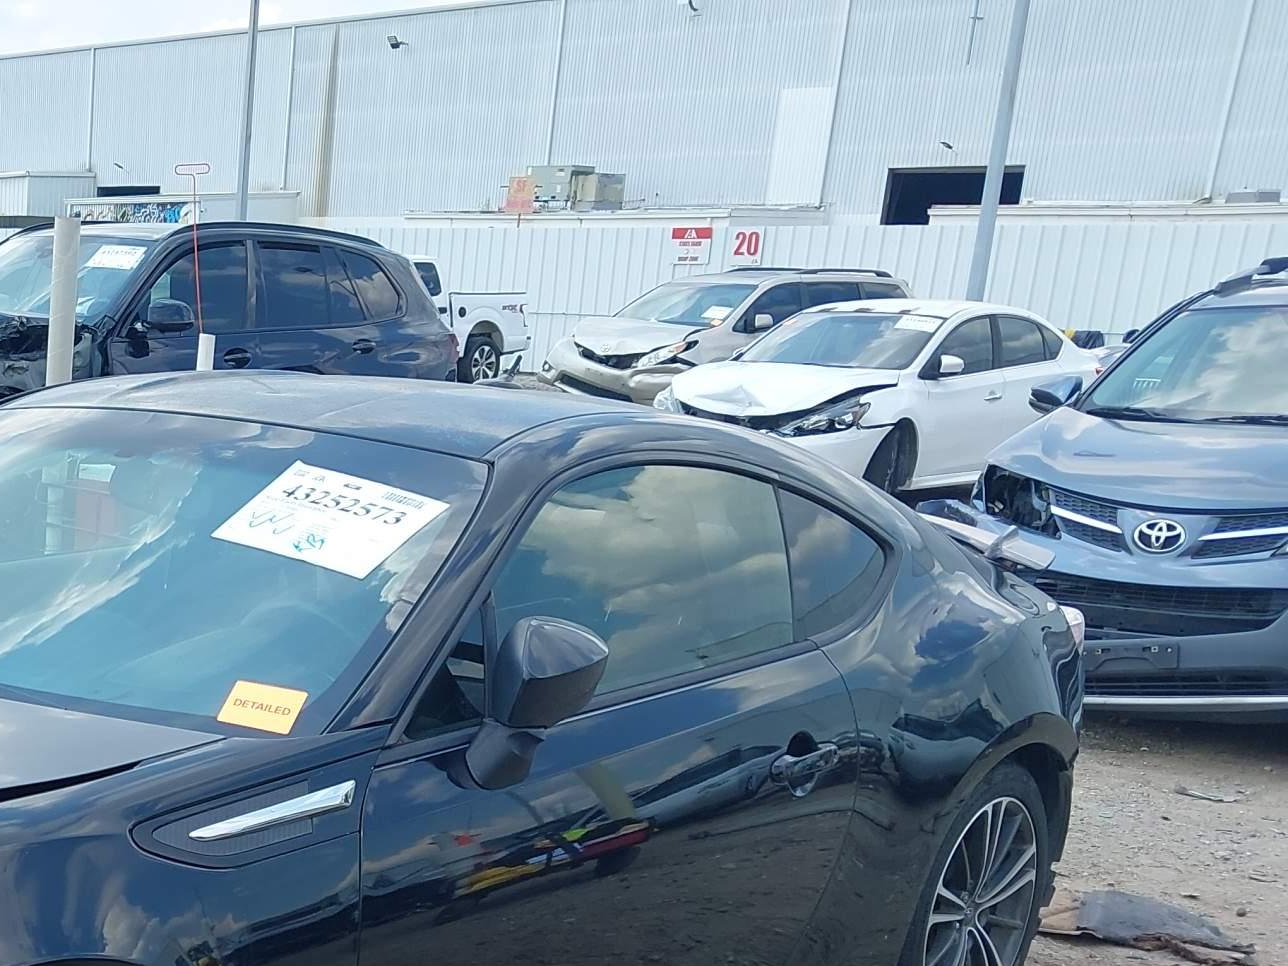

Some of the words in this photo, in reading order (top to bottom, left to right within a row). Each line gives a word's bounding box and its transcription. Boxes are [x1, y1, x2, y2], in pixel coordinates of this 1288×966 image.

[733, 231, 760, 256] 20
[281, 484, 408, 526] 43252573
[232, 698, 292, 716] DETAILED
